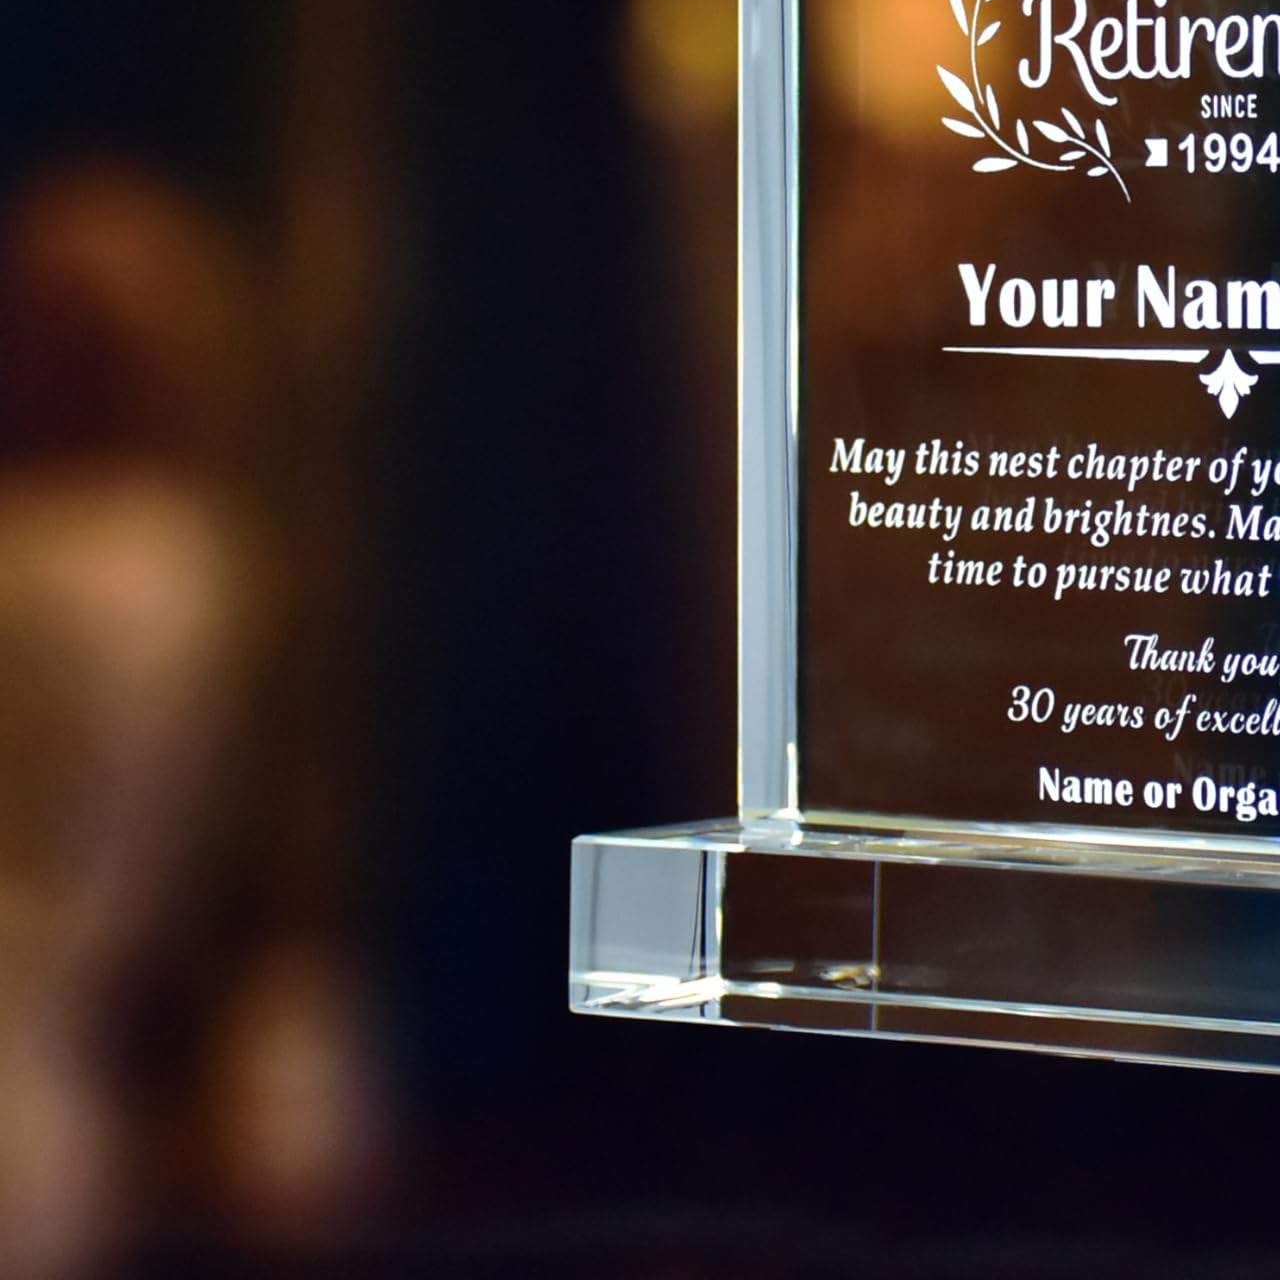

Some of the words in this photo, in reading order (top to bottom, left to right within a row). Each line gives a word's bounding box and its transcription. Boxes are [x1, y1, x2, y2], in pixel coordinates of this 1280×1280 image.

[1200, 93, 1258, 119] SINCE
[957, 263, 1116, 329] Your
[829, 437, 906, 486] May
[915, 438, 980, 477] this
[988, 445, 1061, 479] nest
[1067, 442, 1202, 493] chapter
[1208, 446, 1248, 496] of
[848, 490, 963, 542] beauty
[970, 495, 1036, 533] and
[1043, 496, 1216, 548] brightnes.
[928, 549, 1004, 587] time
[1012, 555, 1048, 589] to
[1054, 563, 1172, 601] pursue
[1180, 559, 1273, 598] what
[1123, 633, 1216, 674] Thank
[1220, 653, 1280, 683] you
[1007, 685, 1055, 723] 30
[1060, 703, 1144, 734] years
[1154, 693, 1197, 742] of
[1039, 766, 1134, 807] Name
[1143, 781, 1183, 809] or
